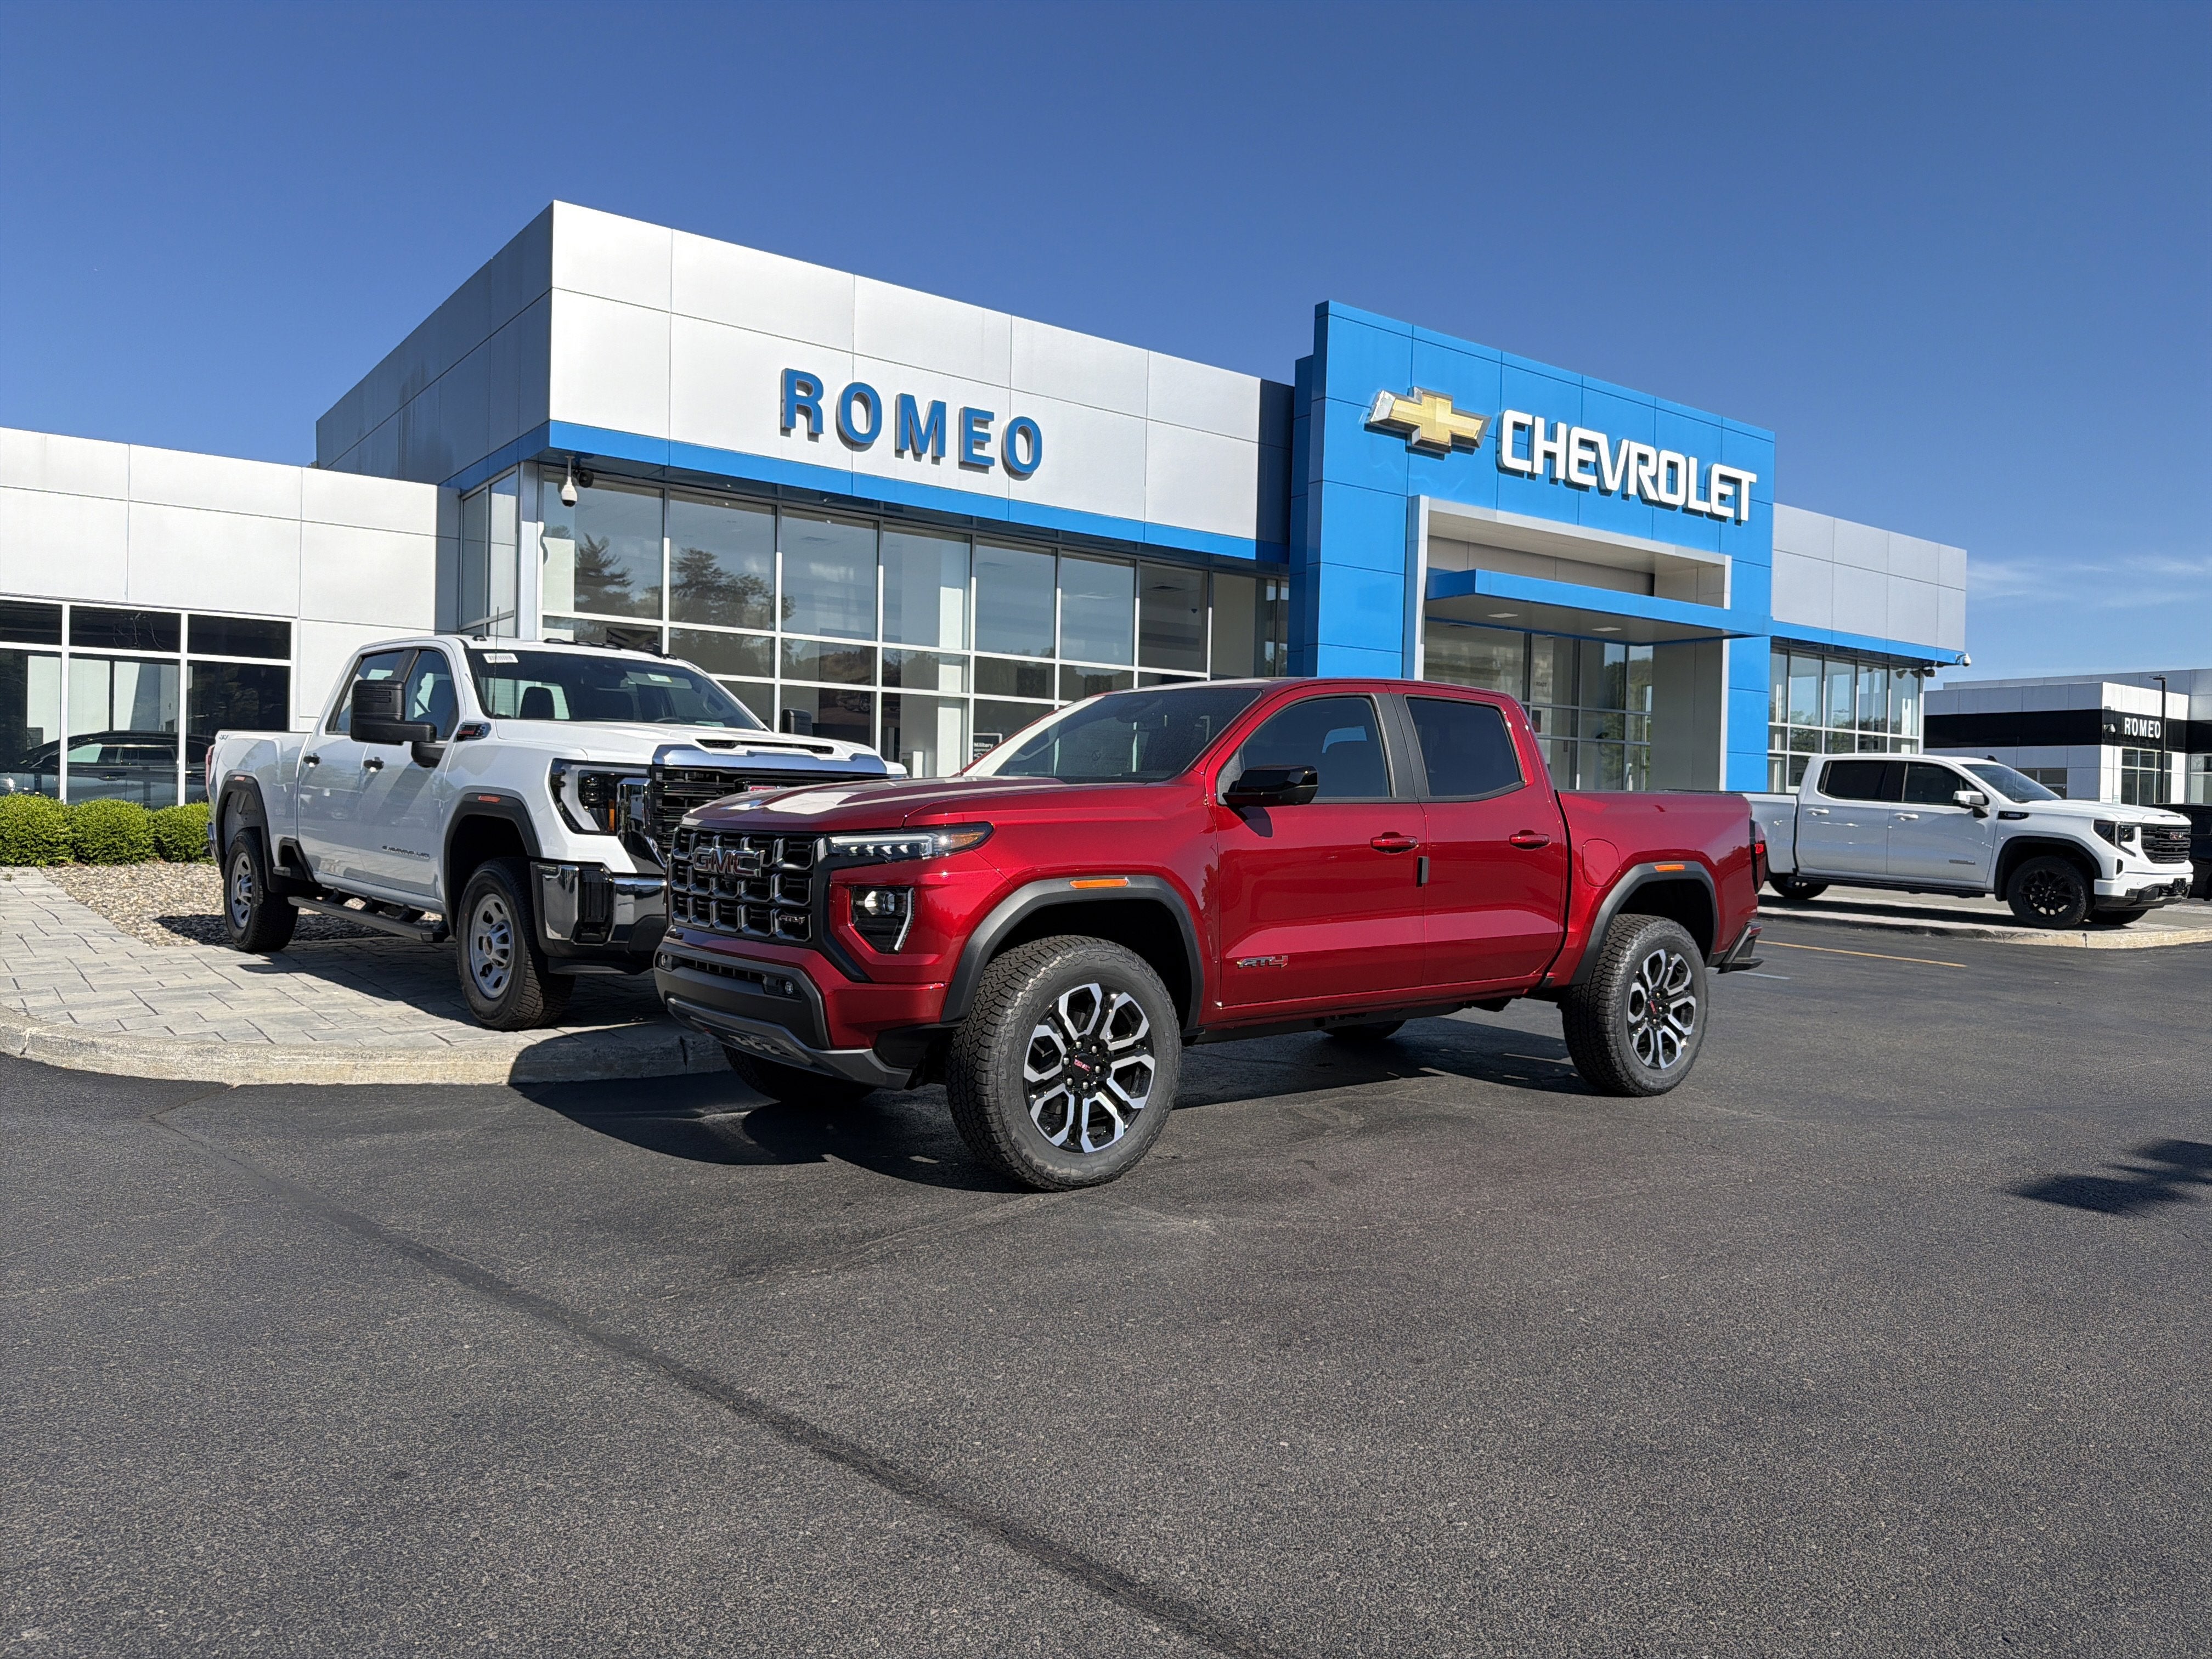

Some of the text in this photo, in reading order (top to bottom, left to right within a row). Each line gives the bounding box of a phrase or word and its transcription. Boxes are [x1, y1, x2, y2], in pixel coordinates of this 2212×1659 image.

[780, 368, 1043, 474] ROMEO
[1498, 409, 1757, 522] CHEVROLET
[2124, 716, 2161, 739] ROMEO
[693, 845, 765, 878] GMC
[1237, 955, 1288, 968] AT4
